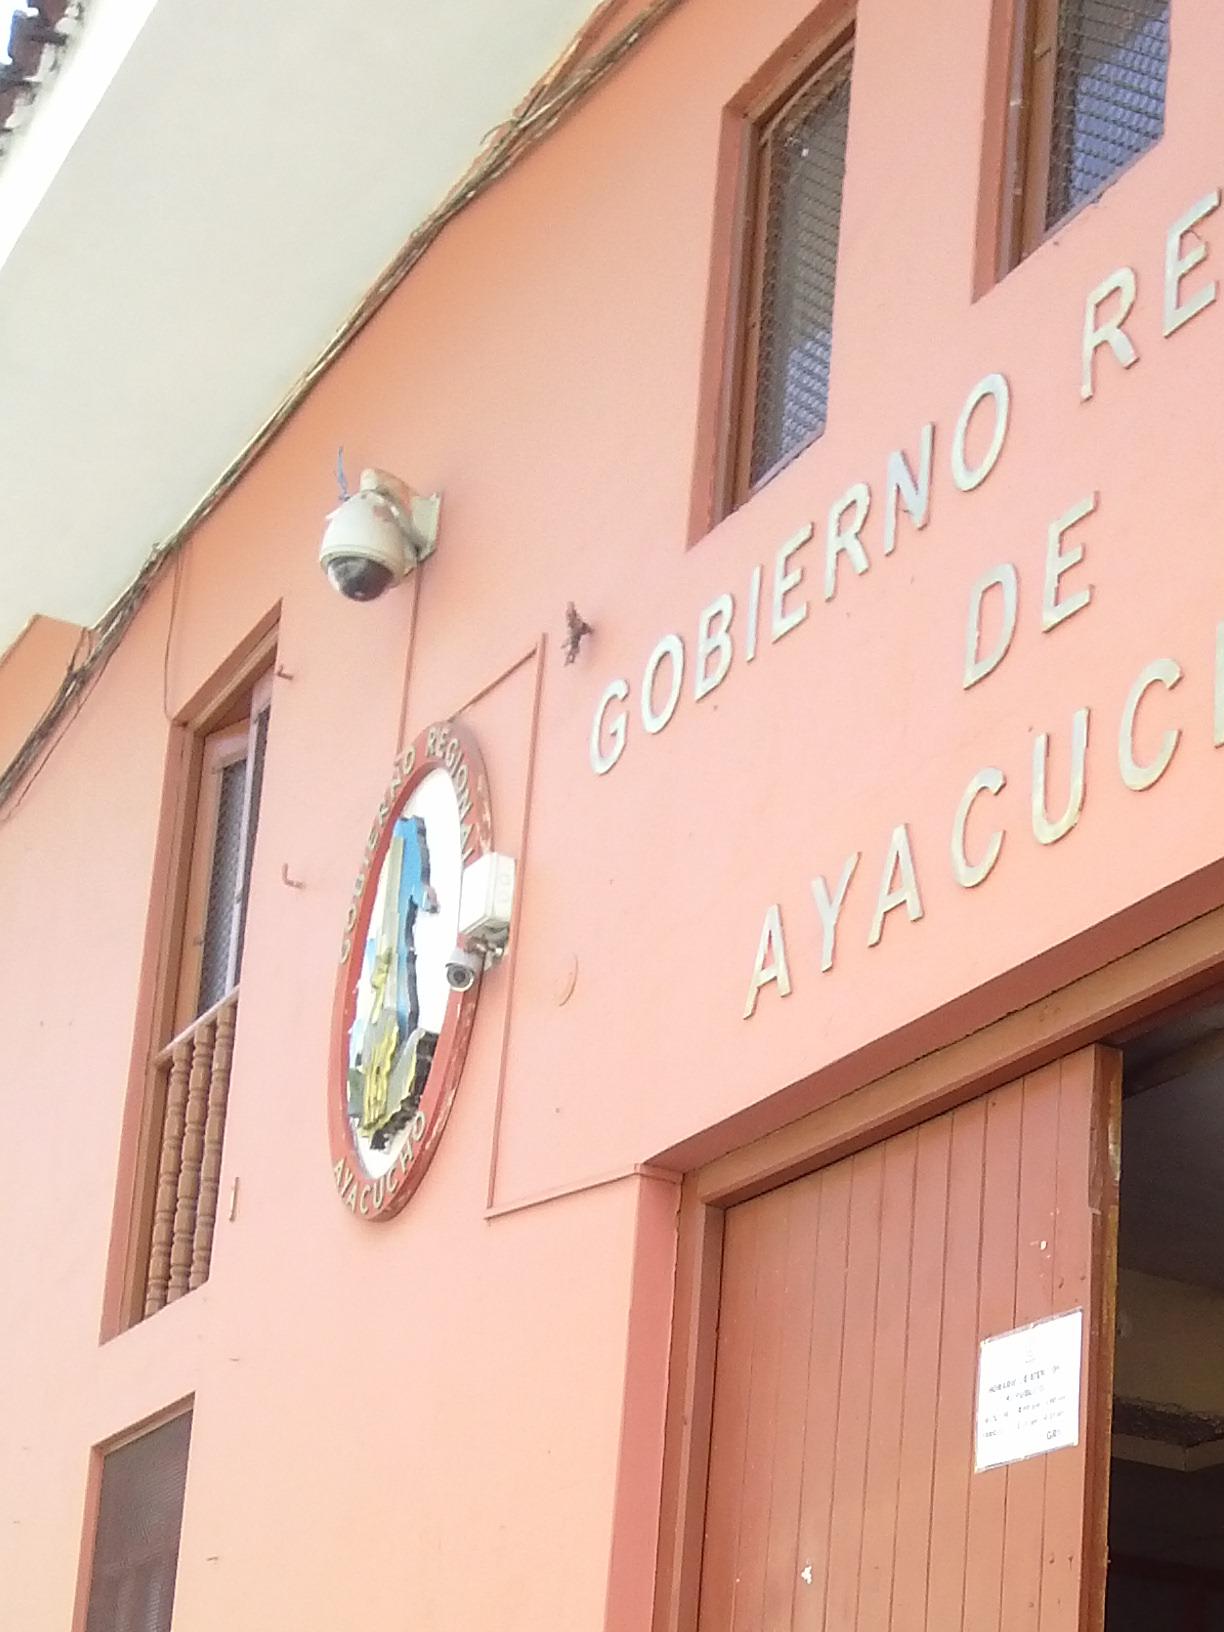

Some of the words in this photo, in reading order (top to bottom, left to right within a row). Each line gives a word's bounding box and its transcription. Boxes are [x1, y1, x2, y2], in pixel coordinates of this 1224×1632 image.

[588, 371, 1012, 777] GOBIERNO
[963, 489, 1098, 691] DE
[334, 1110, 425, 1216] AYACUCHO
